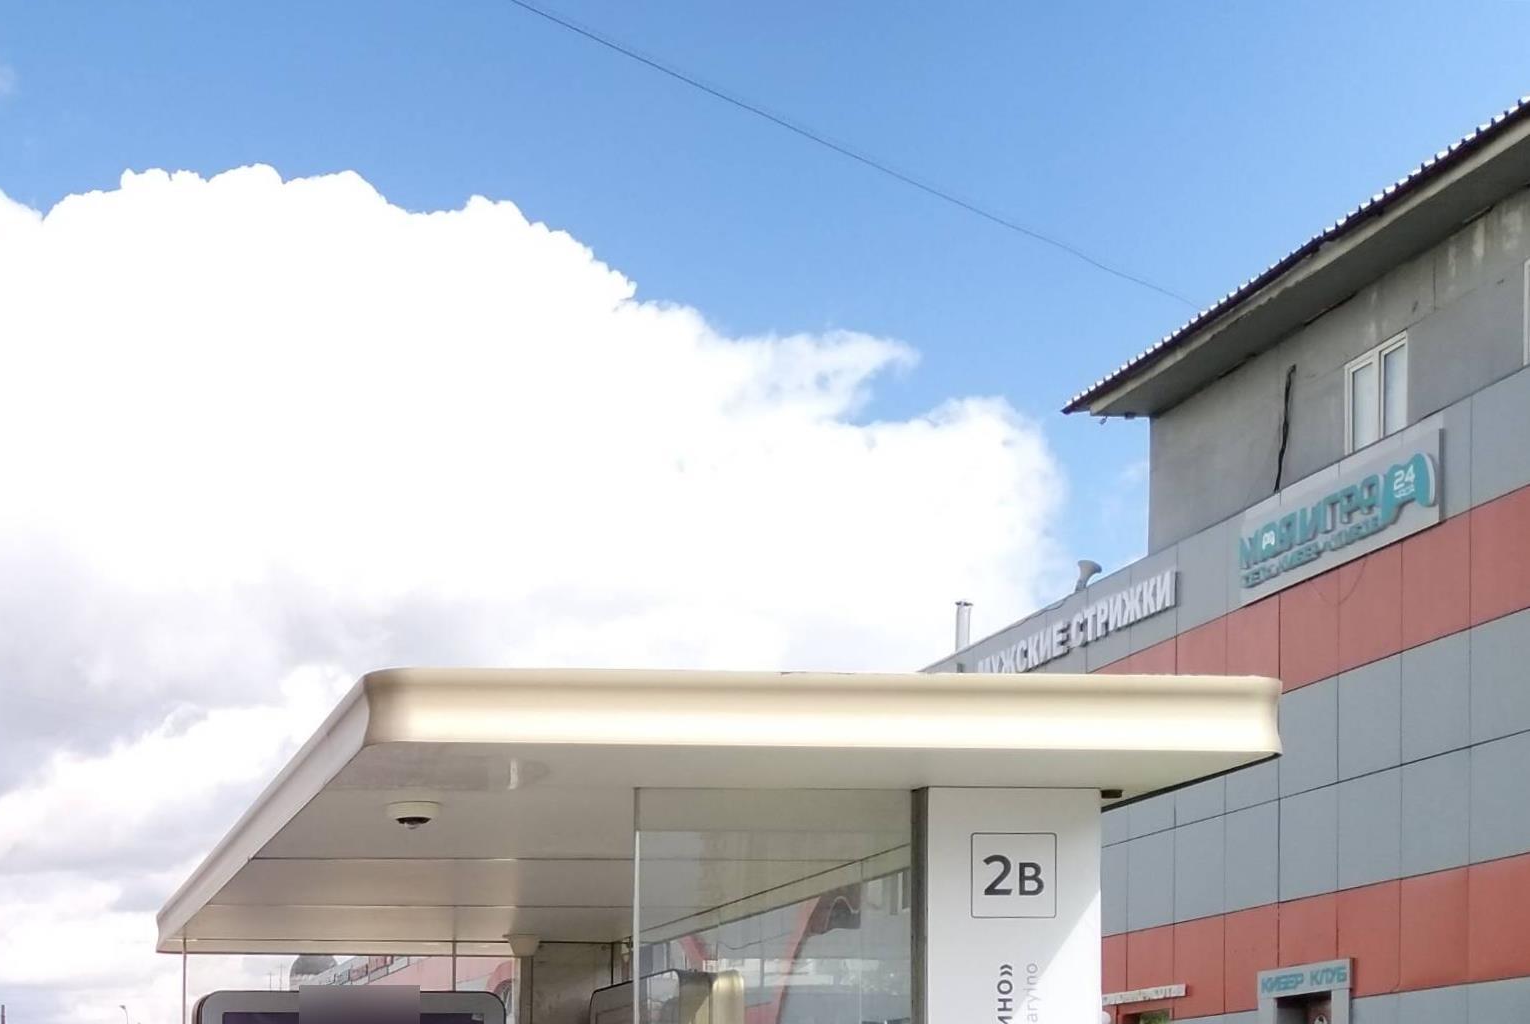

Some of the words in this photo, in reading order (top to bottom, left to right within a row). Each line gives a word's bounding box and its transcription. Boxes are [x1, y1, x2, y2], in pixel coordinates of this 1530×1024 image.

[1393, 464, 1415, 491] 24
[1070, 568, 1176, 648] СТРИЖКИ
[1261, 972, 1304, 994] КИБЕР
[1310, 966, 1348, 986] КЛУБ
